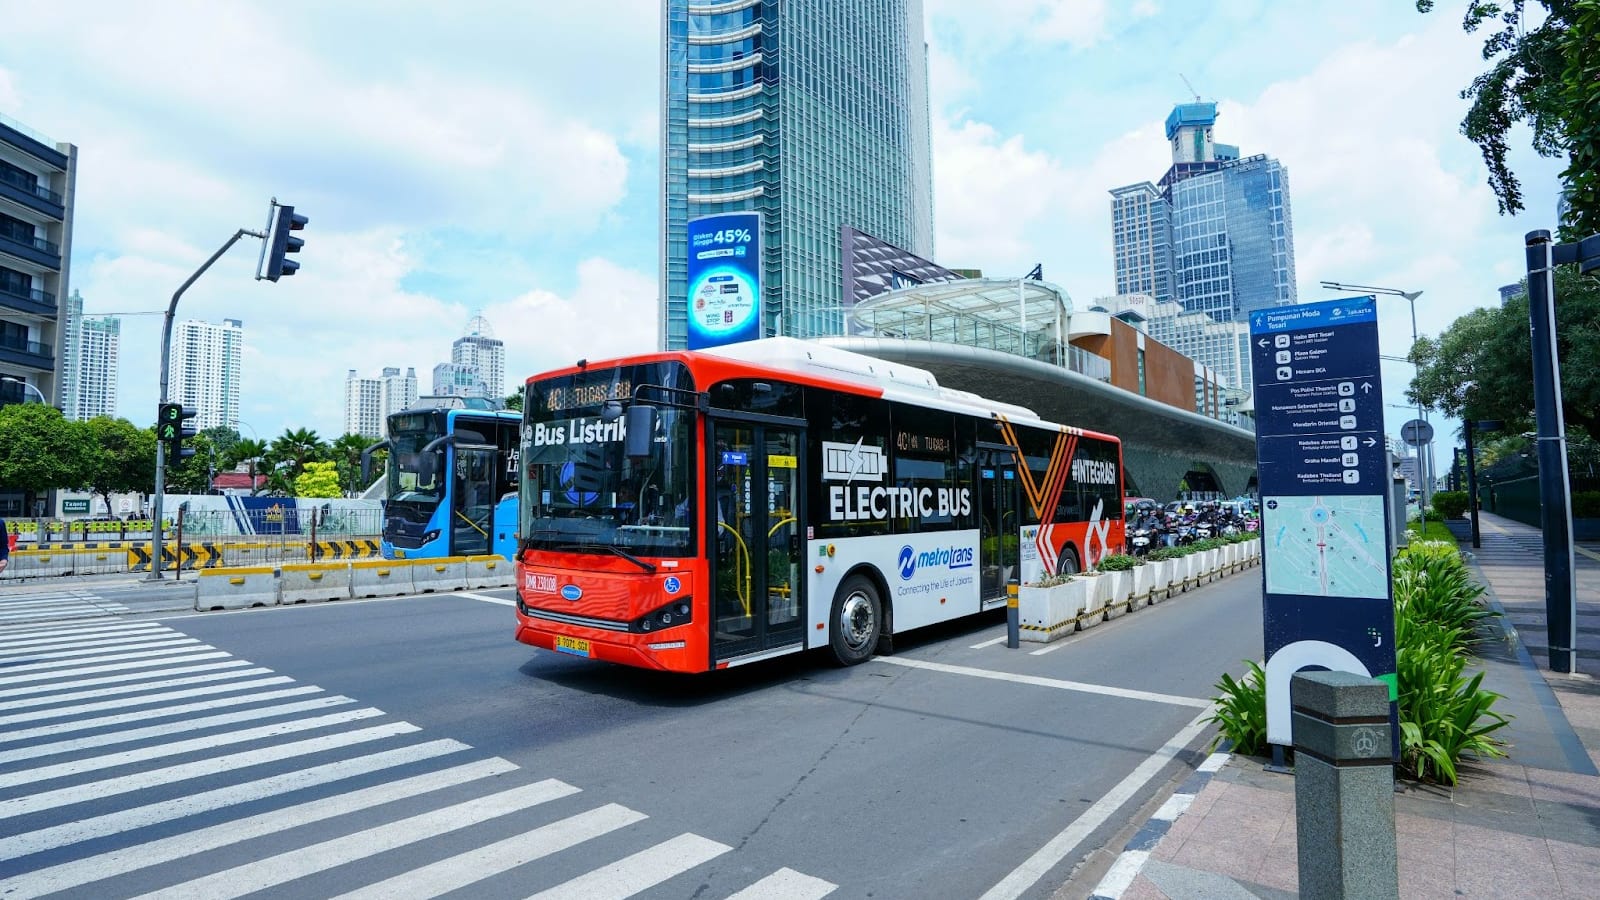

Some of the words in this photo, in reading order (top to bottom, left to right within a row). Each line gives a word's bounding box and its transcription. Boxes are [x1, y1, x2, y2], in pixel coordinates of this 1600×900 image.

[714, 228, 751, 244] 45%
[1301, 310, 1321, 318] Moda
[548, 389, 562, 411] 4C
[169, 408, 178, 419] 3
[534, 423, 566, 447] Bus
[569, 416, 627, 444] Listrik
[897, 431, 908, 450] 4C
[507, 448, 519, 460] Ja
[1072, 458, 1116, 485] #INTEGRASI
[830, 486, 933, 520] ELECTRIC
[938, 487, 971, 517] BUS
[917, 545, 973, 569] metrotrans
[898, 585, 930, 596] Connecting
[930, 580, 939, 590] the
